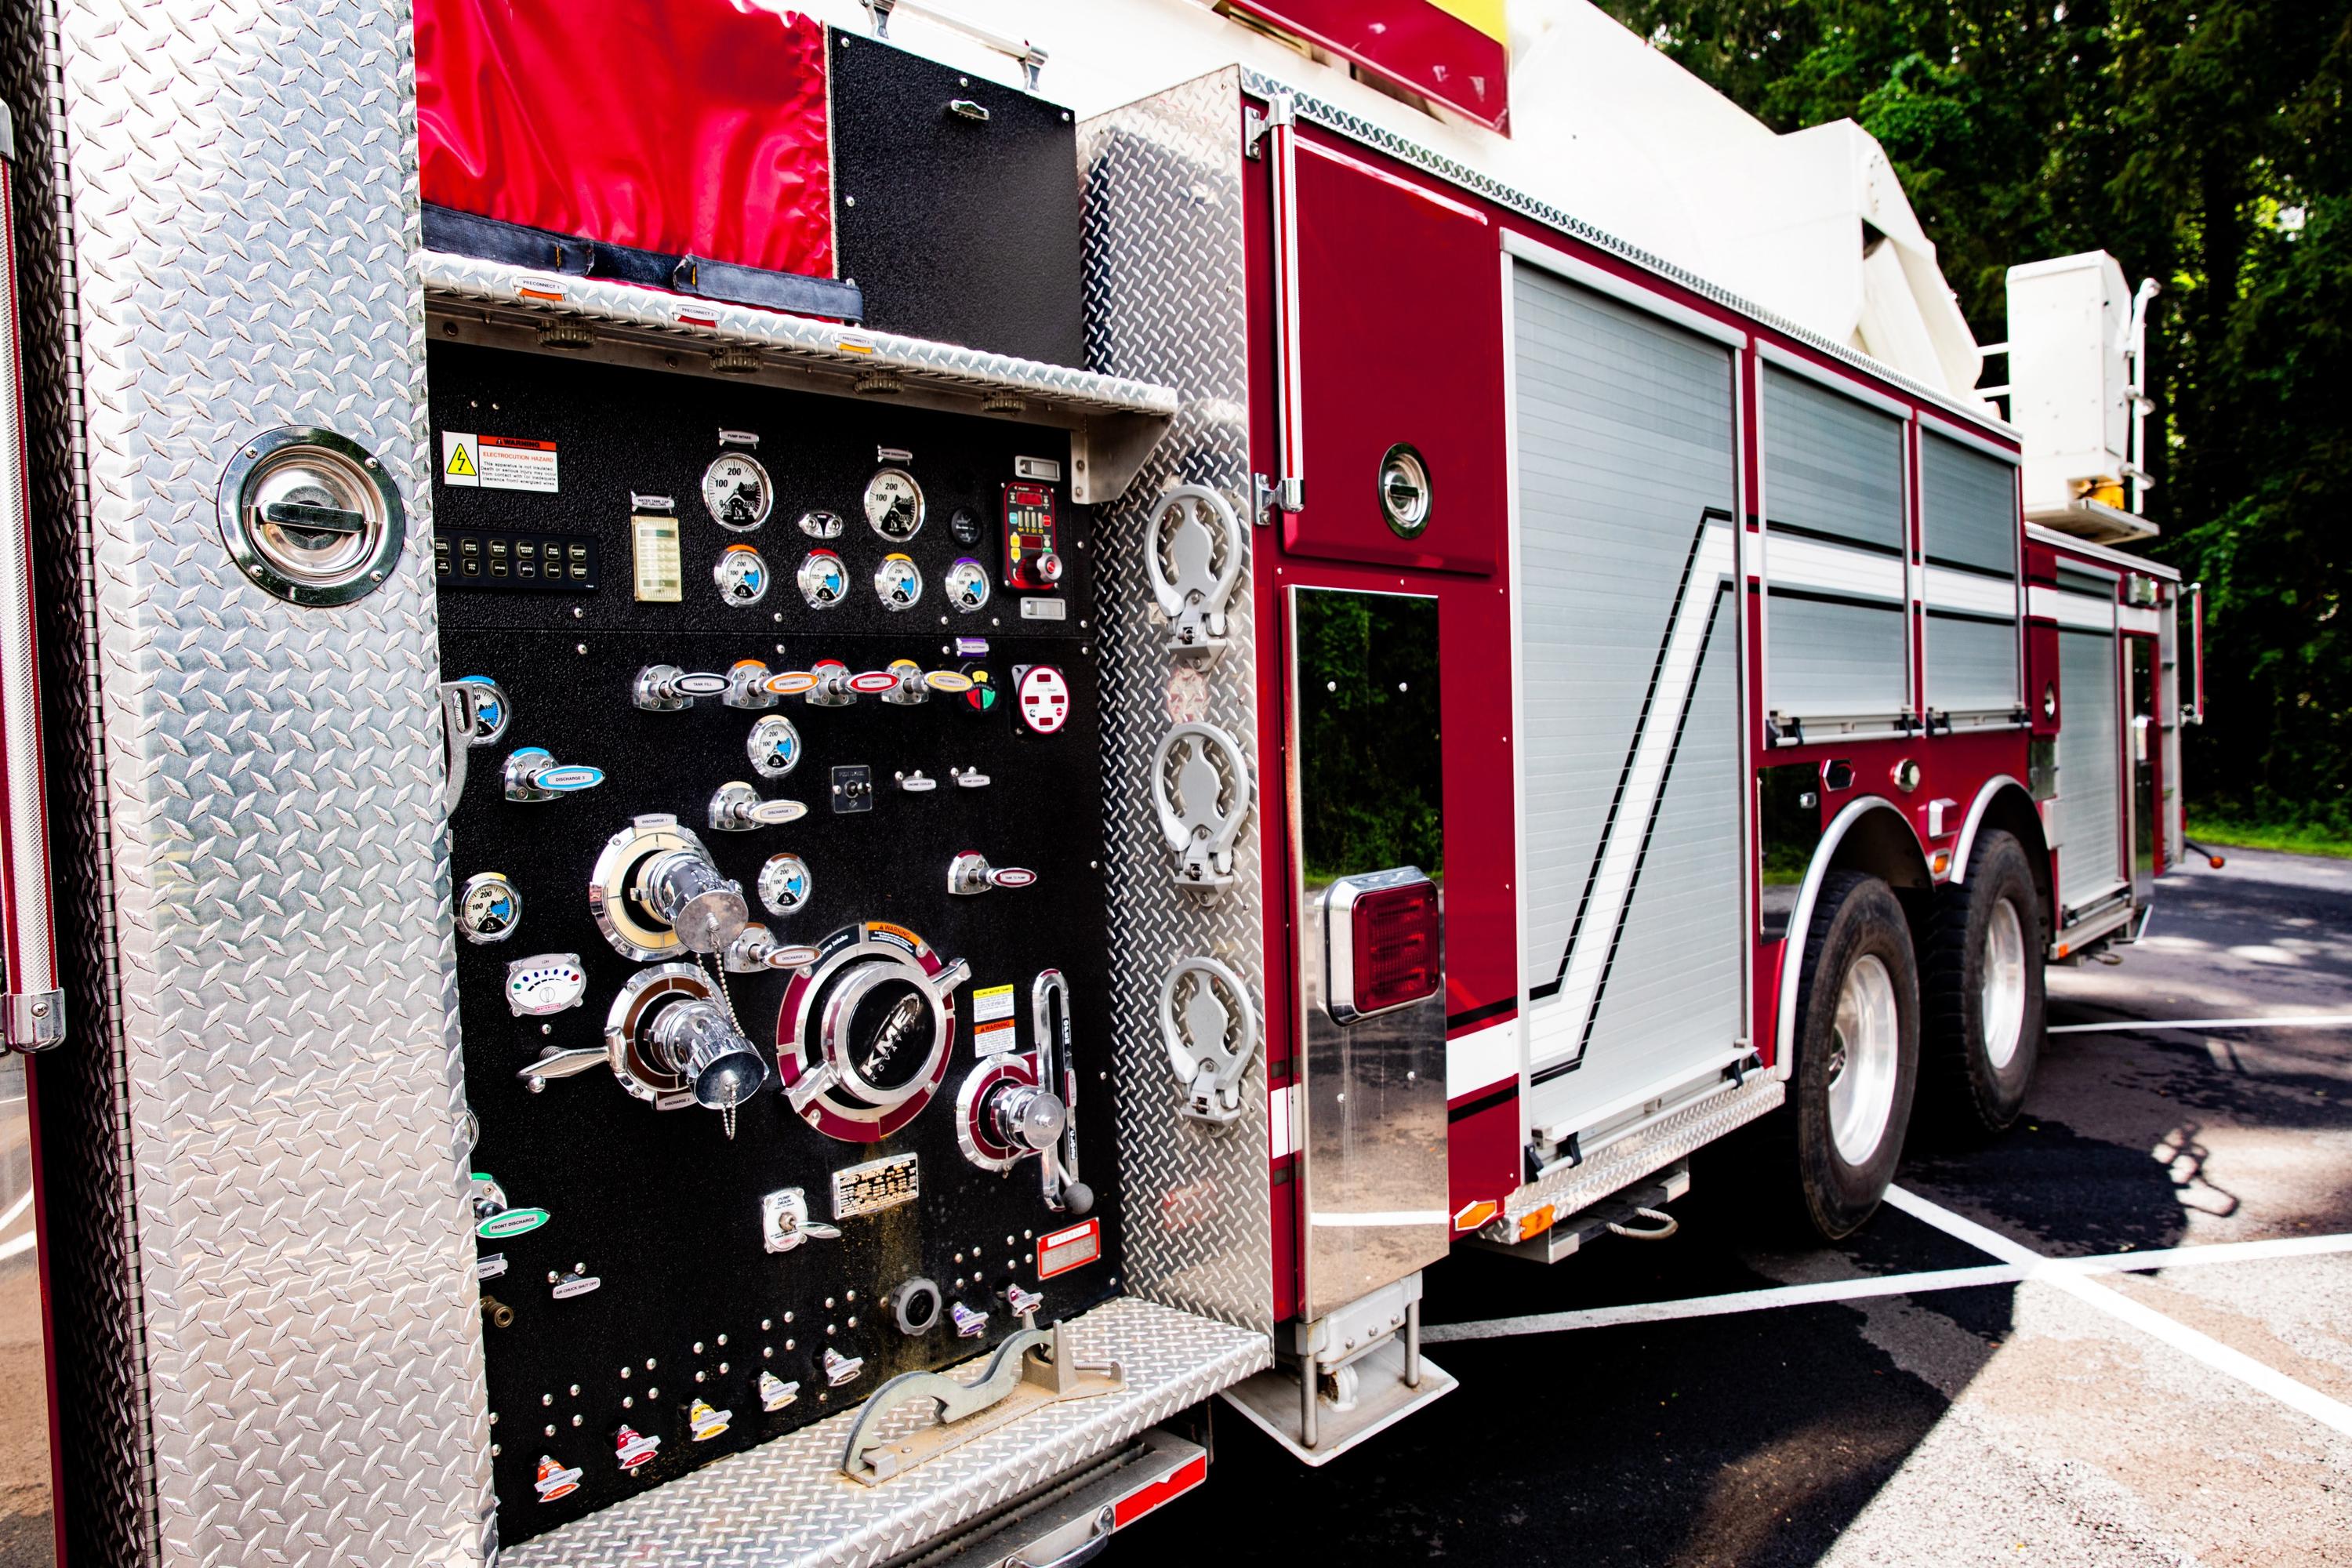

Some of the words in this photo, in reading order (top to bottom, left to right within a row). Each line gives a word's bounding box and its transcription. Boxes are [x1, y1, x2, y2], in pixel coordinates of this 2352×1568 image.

[523, 280, 555, 289] PRECONNECT
[682, 307, 710, 316] PRECONNECT
[504, 438, 540, 448] WARNING
[483, 451, 529, 461] ELECTROCUTION
[728, 467, 742, 476] 200
[715, 479, 728, 488] 100
[885, 482, 898, 491] 200
[884, 924, 910, 938] WARNING
[822, 944, 832, 955] ump
[833, 935, 849, 947] Intake
[985, 1021, 1010, 1031] WARNING
[861, 1005, 912, 1077] KME
[508, 1217, 535, 1227] DISCHARGE
[697, 1414, 722, 1425] PRECONNECT
[623, 1441, 650, 1454] PRECONNECT
[543, 1472, 572, 1486] PRECONNECT
